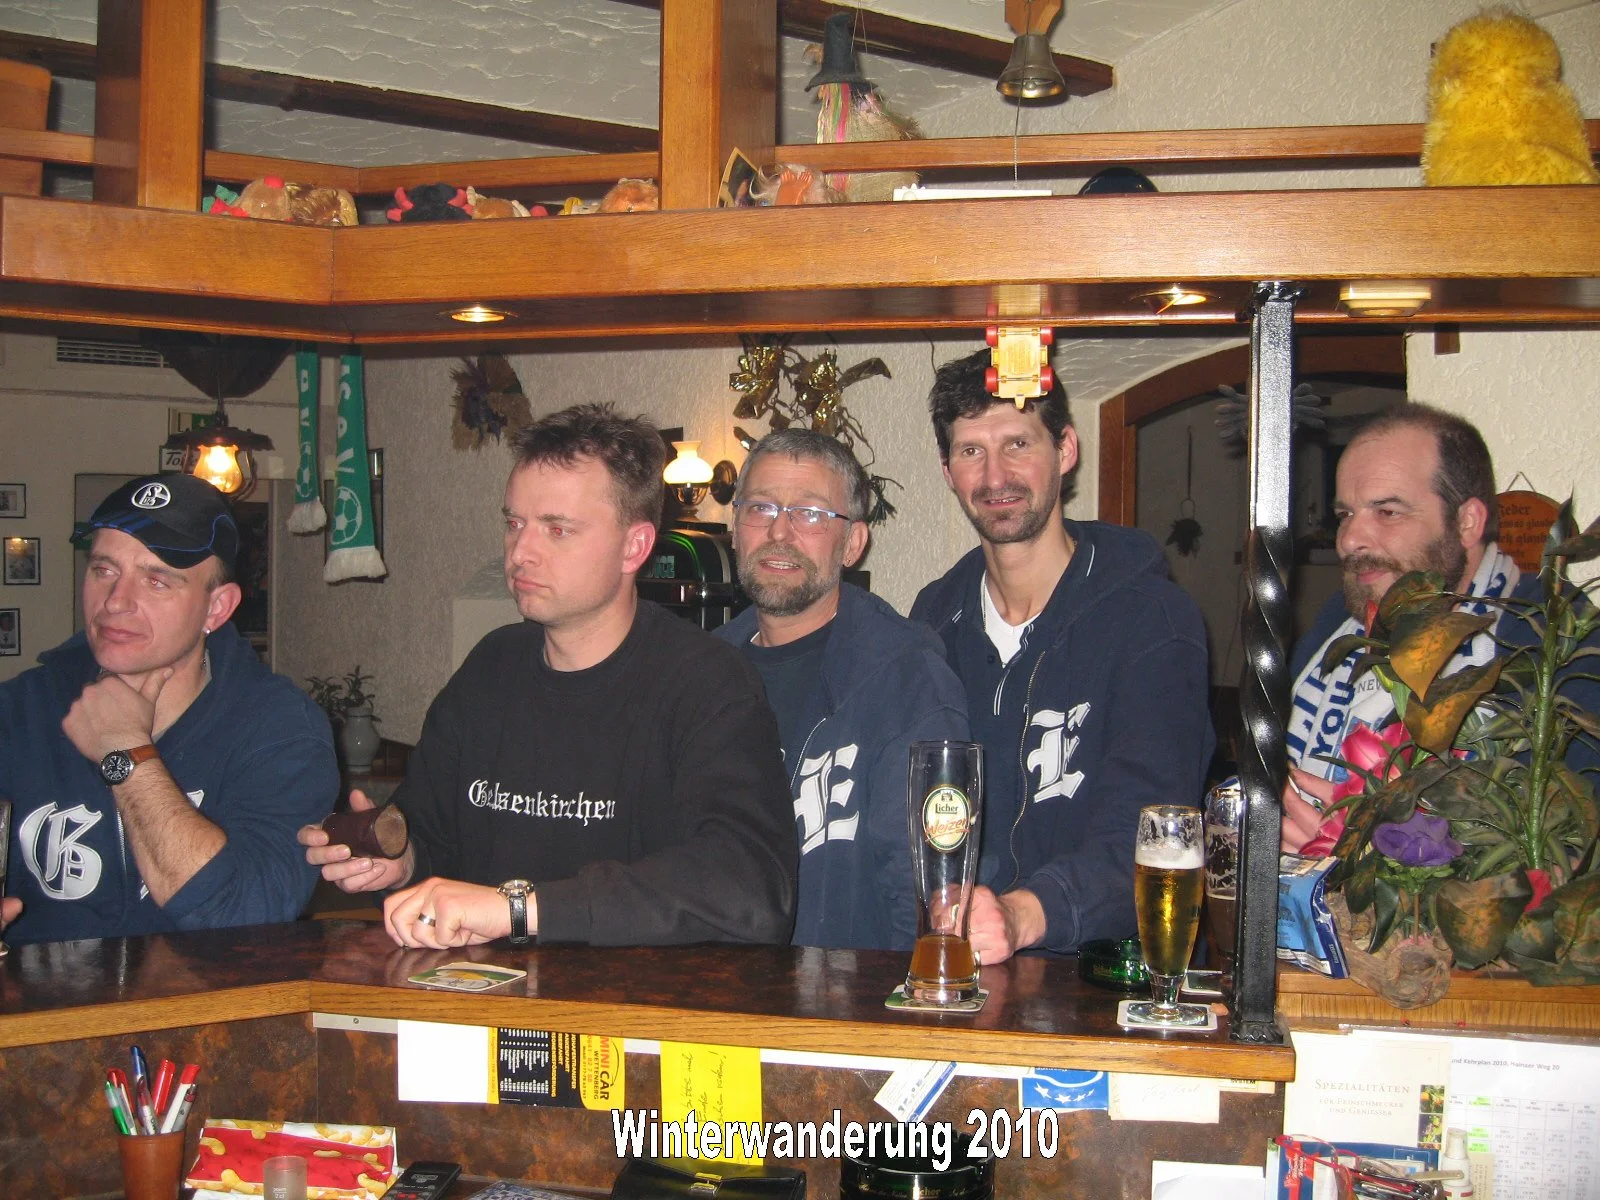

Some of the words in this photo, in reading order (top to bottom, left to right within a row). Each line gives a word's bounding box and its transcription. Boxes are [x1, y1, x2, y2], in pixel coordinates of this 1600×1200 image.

[468, 779, 616, 827] Gelsenkirchen
[935, 802, 959, 814] Licher
[600, 1071, 610, 1101] CAR
[1314, 1078, 1410, 1094] SPEZIALITÄTEN
